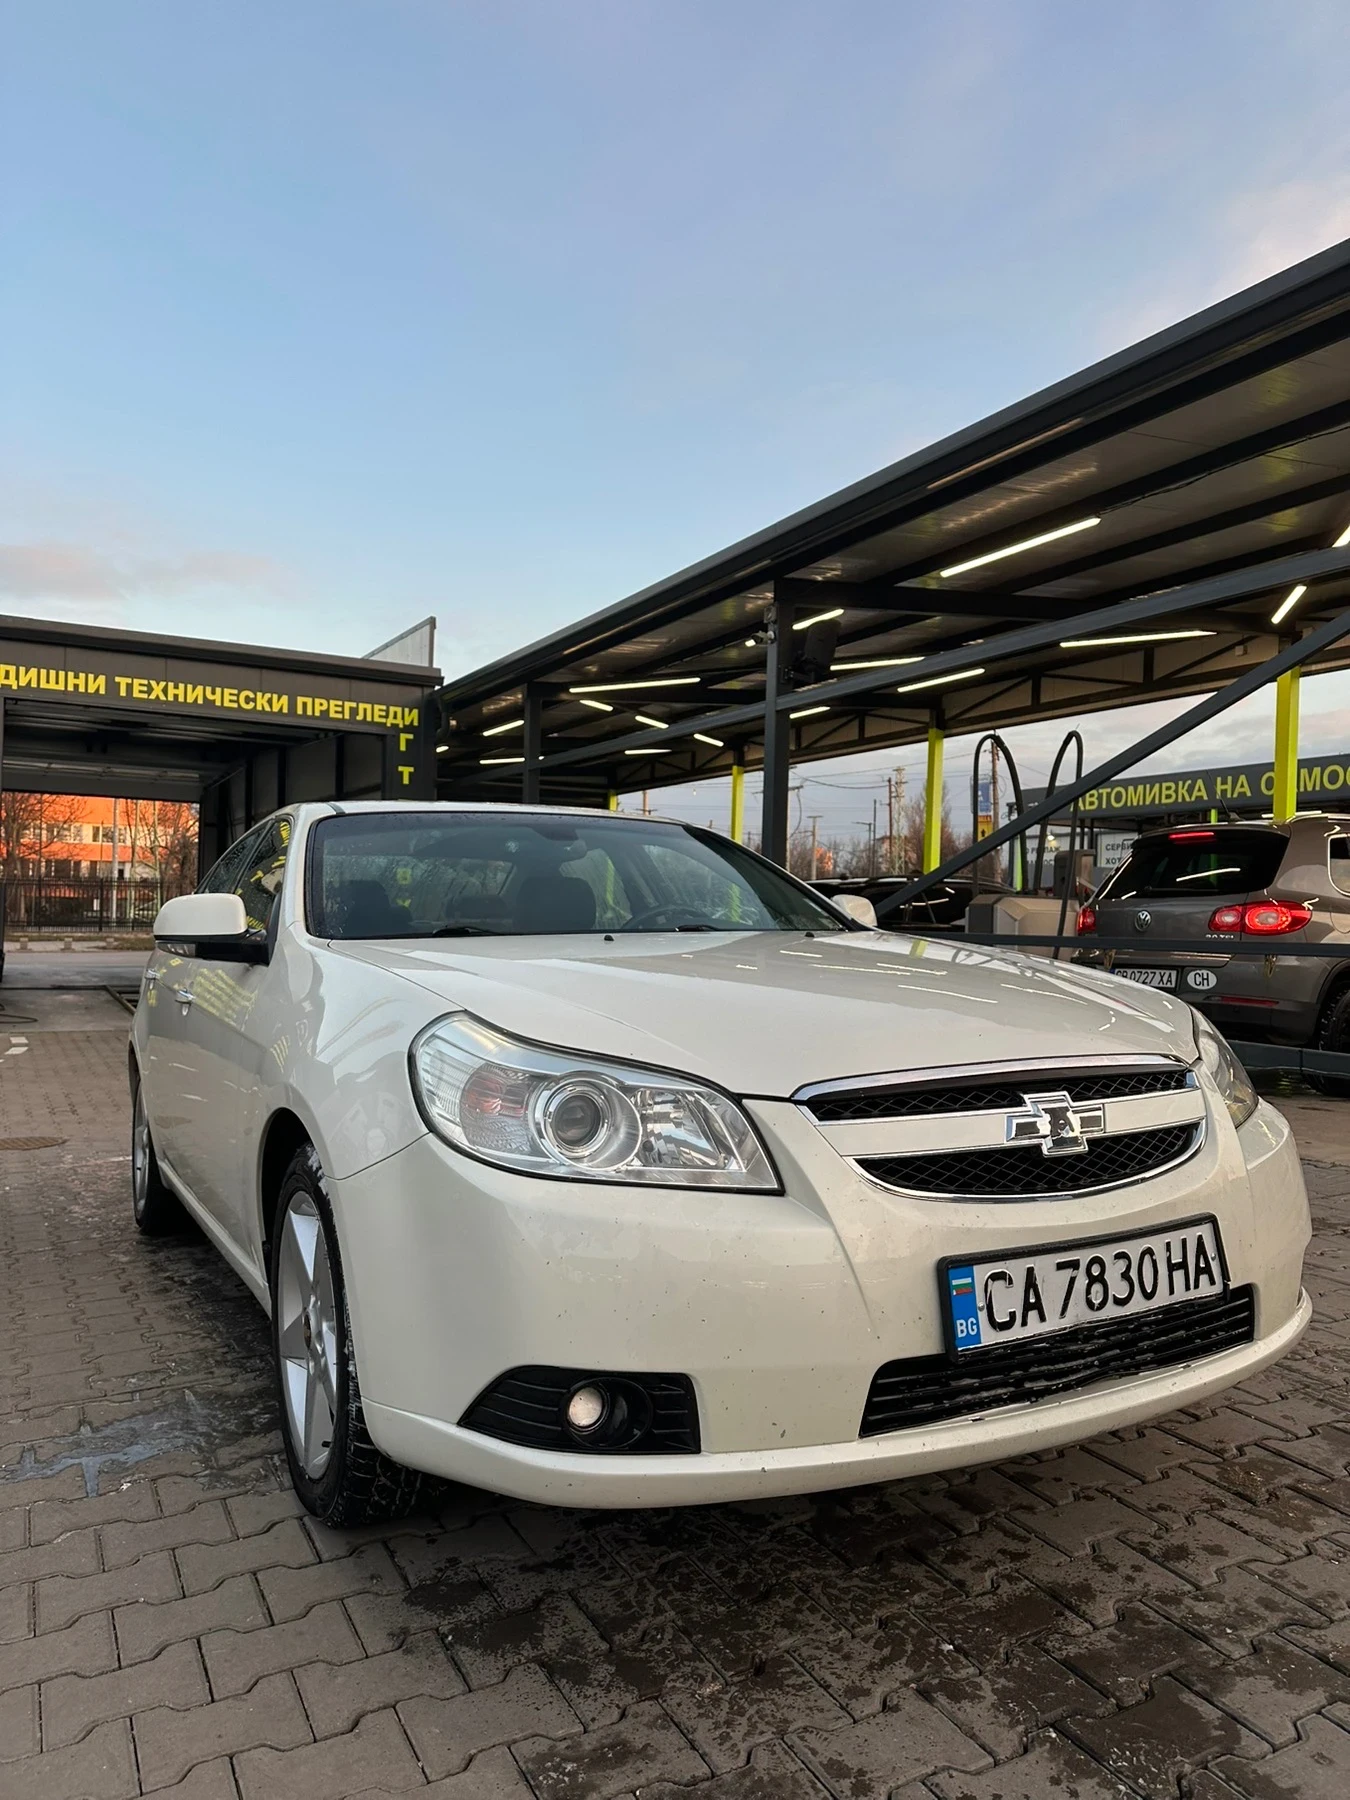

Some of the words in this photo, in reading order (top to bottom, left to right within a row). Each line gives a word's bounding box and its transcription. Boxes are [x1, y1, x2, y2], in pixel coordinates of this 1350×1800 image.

[0, 664, 106, 695] ДИШНИ
[114, 676, 288, 713] ТЕХНИЧЕСКИ
[297, 697, 419, 728] ПРЕГЛЕДИ
[1216, 774, 1251, 799] НА
[1193, 972, 1210, 987] CH
[984, 1264, 1047, 1332] CA
[957, 1318, 977, 1338] BG
